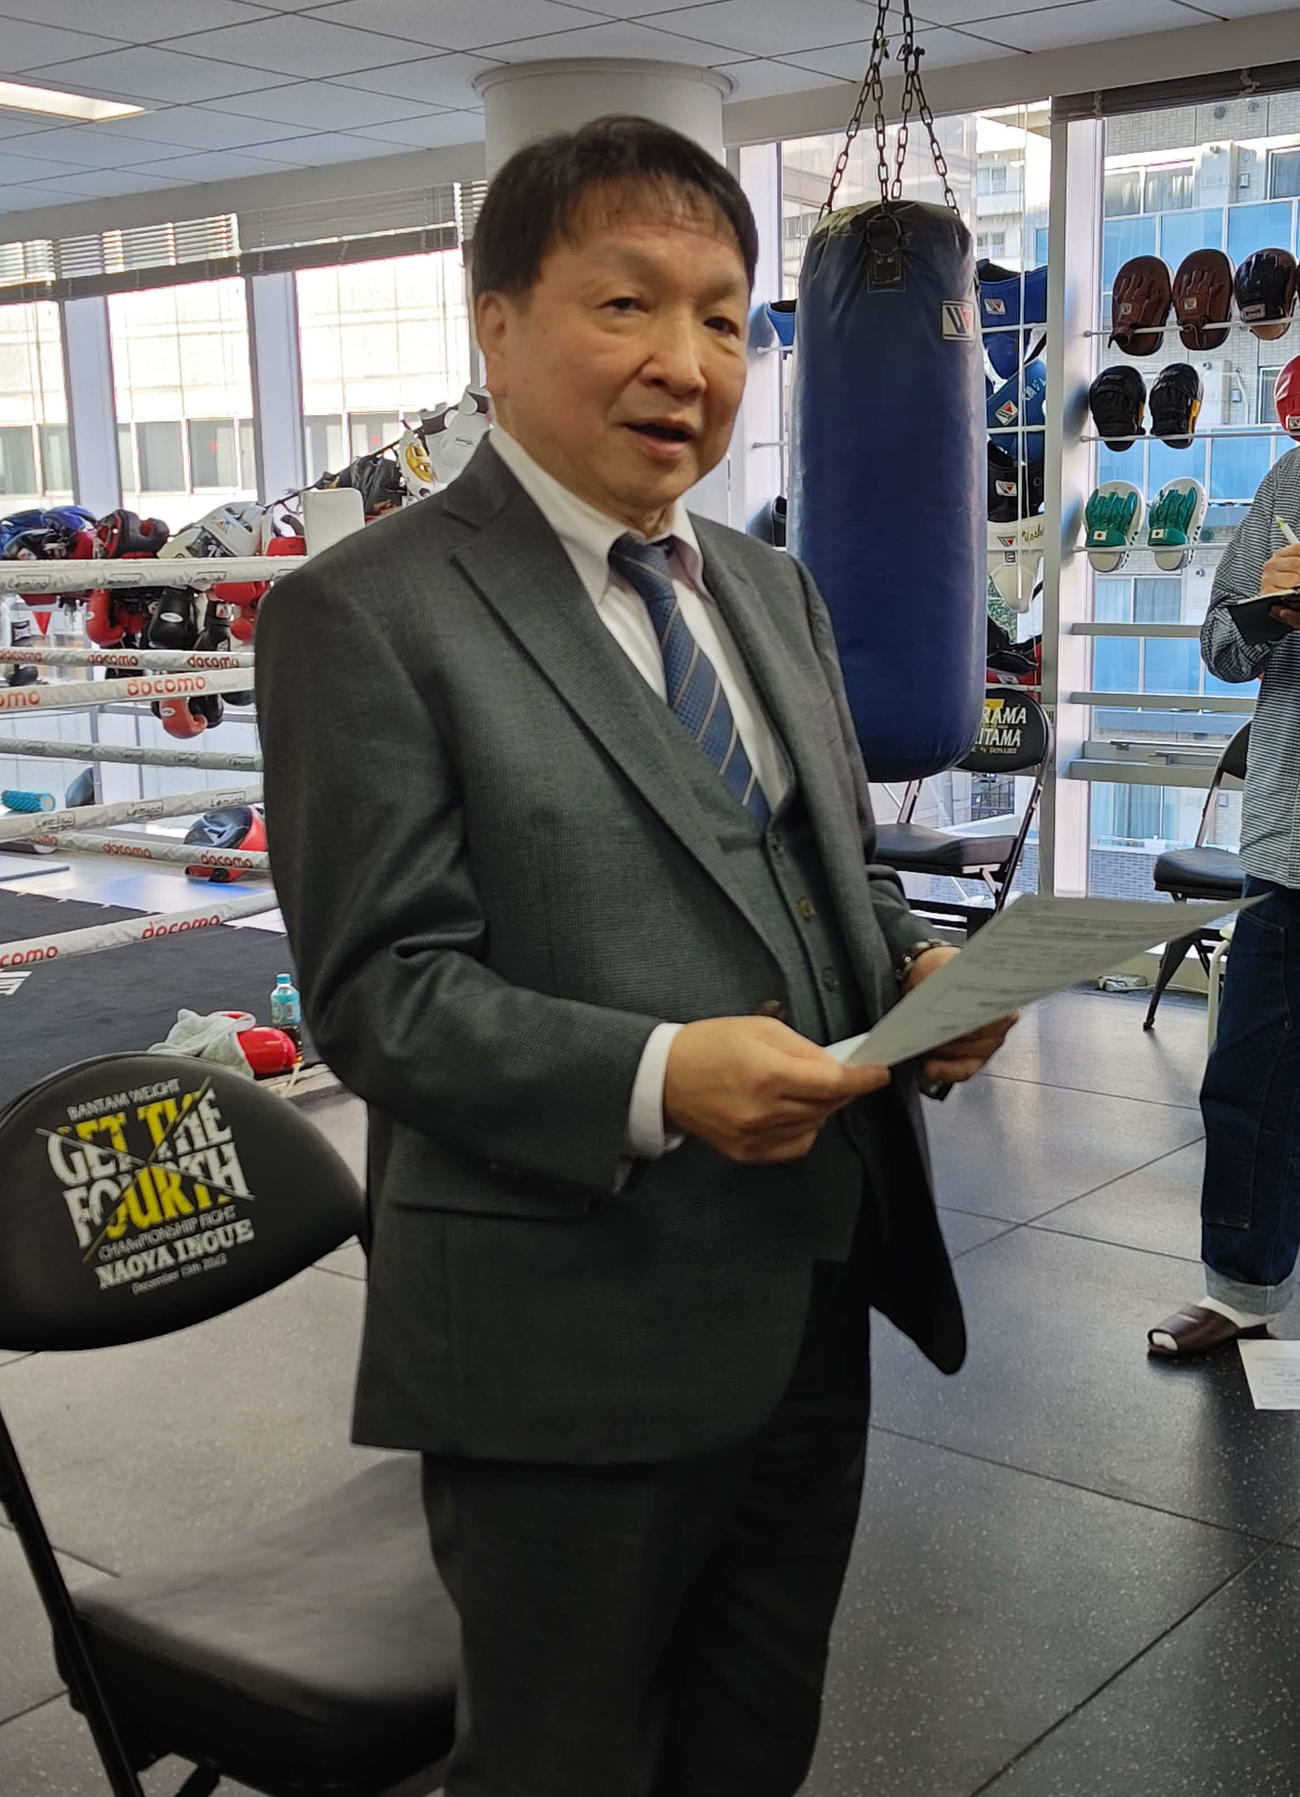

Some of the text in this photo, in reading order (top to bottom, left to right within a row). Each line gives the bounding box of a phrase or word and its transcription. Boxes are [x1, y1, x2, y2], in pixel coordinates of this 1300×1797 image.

[88, 652, 139, 667] docomo
[187, 654, 240, 669] docomo
[127, 675, 207, 698] docomo
[974, 728, 1022, 748] ITAMA
[102, 842, 153, 859] docomo
[200, 852, 254, 869] docomo
[142, 914, 221, 940] docomo
[67, 1078, 181, 1121] BANTAM WEIGHT
[47, 1088, 234, 1186] GET THE
[63, 1142, 251, 1249] FOURTH
[98, 1204, 237, 1261] CHAMPIONSHIP FIGHT
[95, 1218, 255, 1290] NAOYA INOUE
